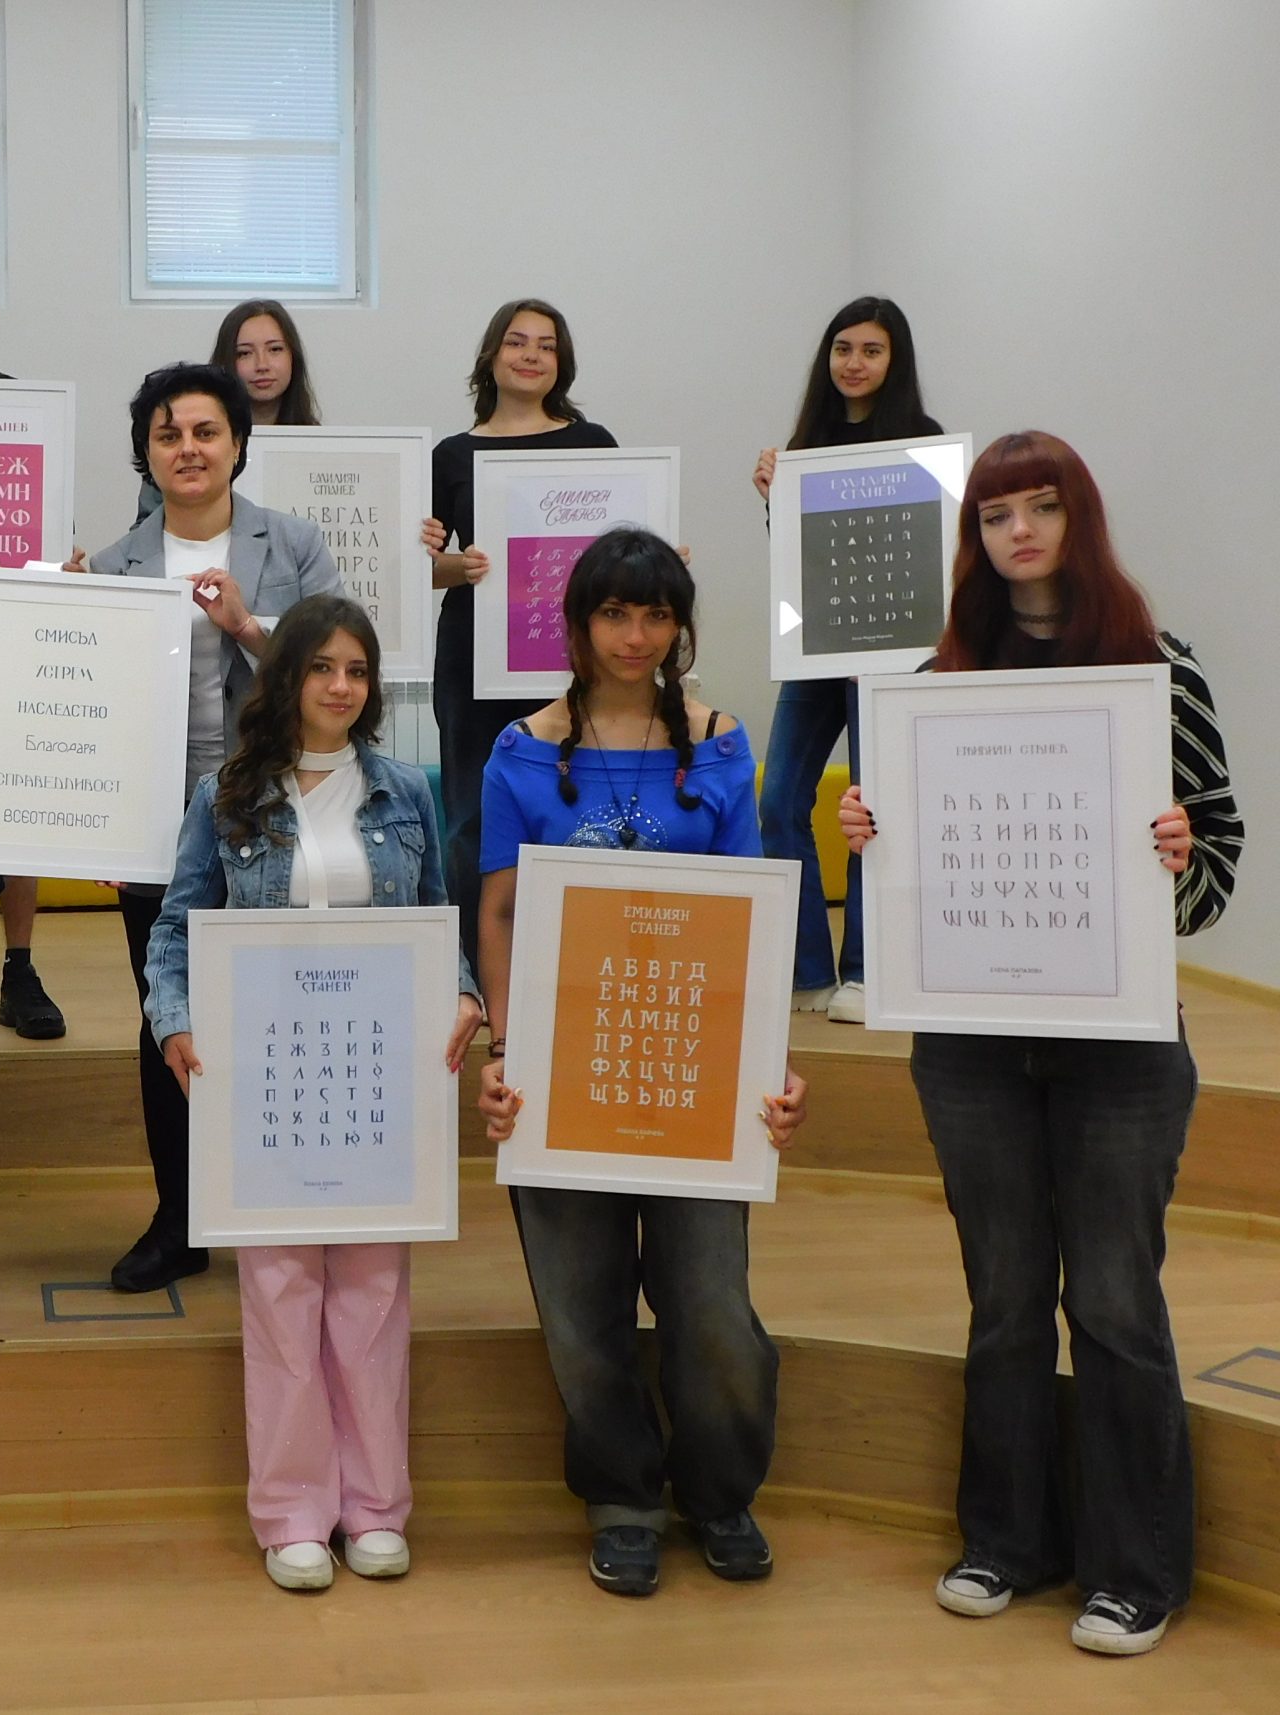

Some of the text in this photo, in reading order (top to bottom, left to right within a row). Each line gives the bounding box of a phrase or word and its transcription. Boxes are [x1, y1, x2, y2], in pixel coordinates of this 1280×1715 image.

[309, 472, 360, 484] ЕМИЛИЯН
[314, 485, 356, 496] СТАНЕВ
[34, 628, 98, 646] СМИСЪЛ
[36, 665, 93, 681] УСТРЕМ
[18, 701, 108, 719] НАСЛЕДСТВО
[25, 735, 96, 755] Благодаря
[624, 906, 690, 921] ЕМИЛИЯН
[630, 922, 681, 936] СТАНЕВ
[295, 969, 359, 981] ЕМИЛИЯН
[302, 981, 352, 994] СТАНЕВ
